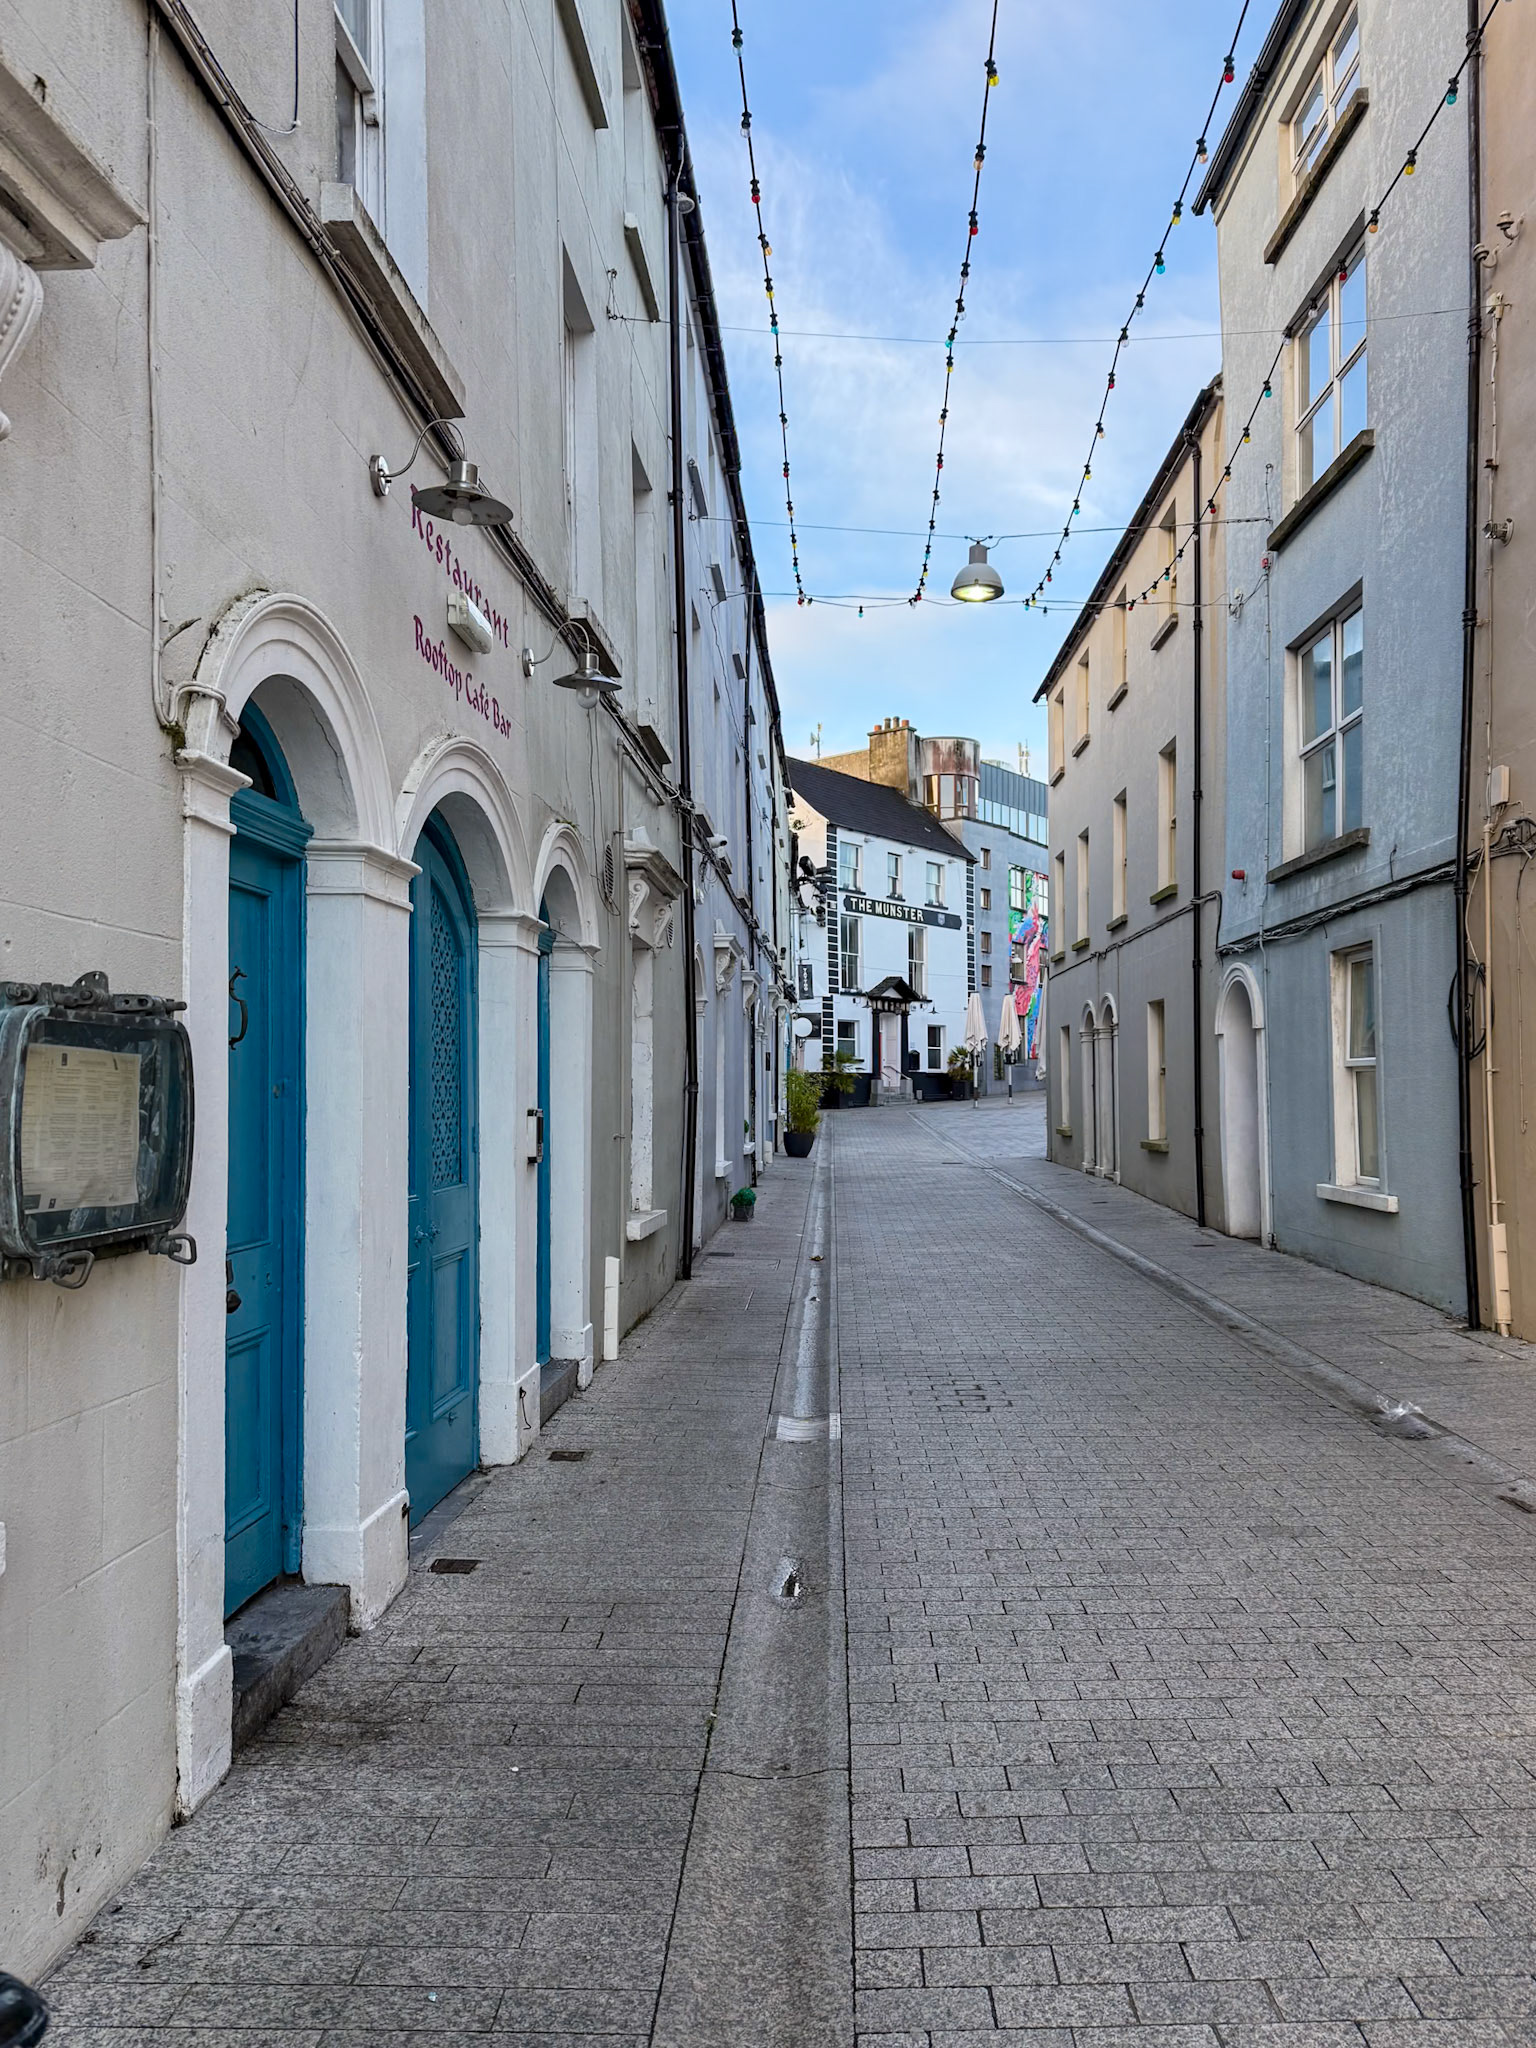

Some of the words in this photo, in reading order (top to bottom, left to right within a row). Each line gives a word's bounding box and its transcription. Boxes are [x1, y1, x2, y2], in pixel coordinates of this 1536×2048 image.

[413, 614, 462, 701] Rooftop
[465, 672, 490, 720] Café
[492, 697, 511, 739] Bar
[850, 897, 873, 913] THE
[875, 901, 924, 922] MUNSTER
